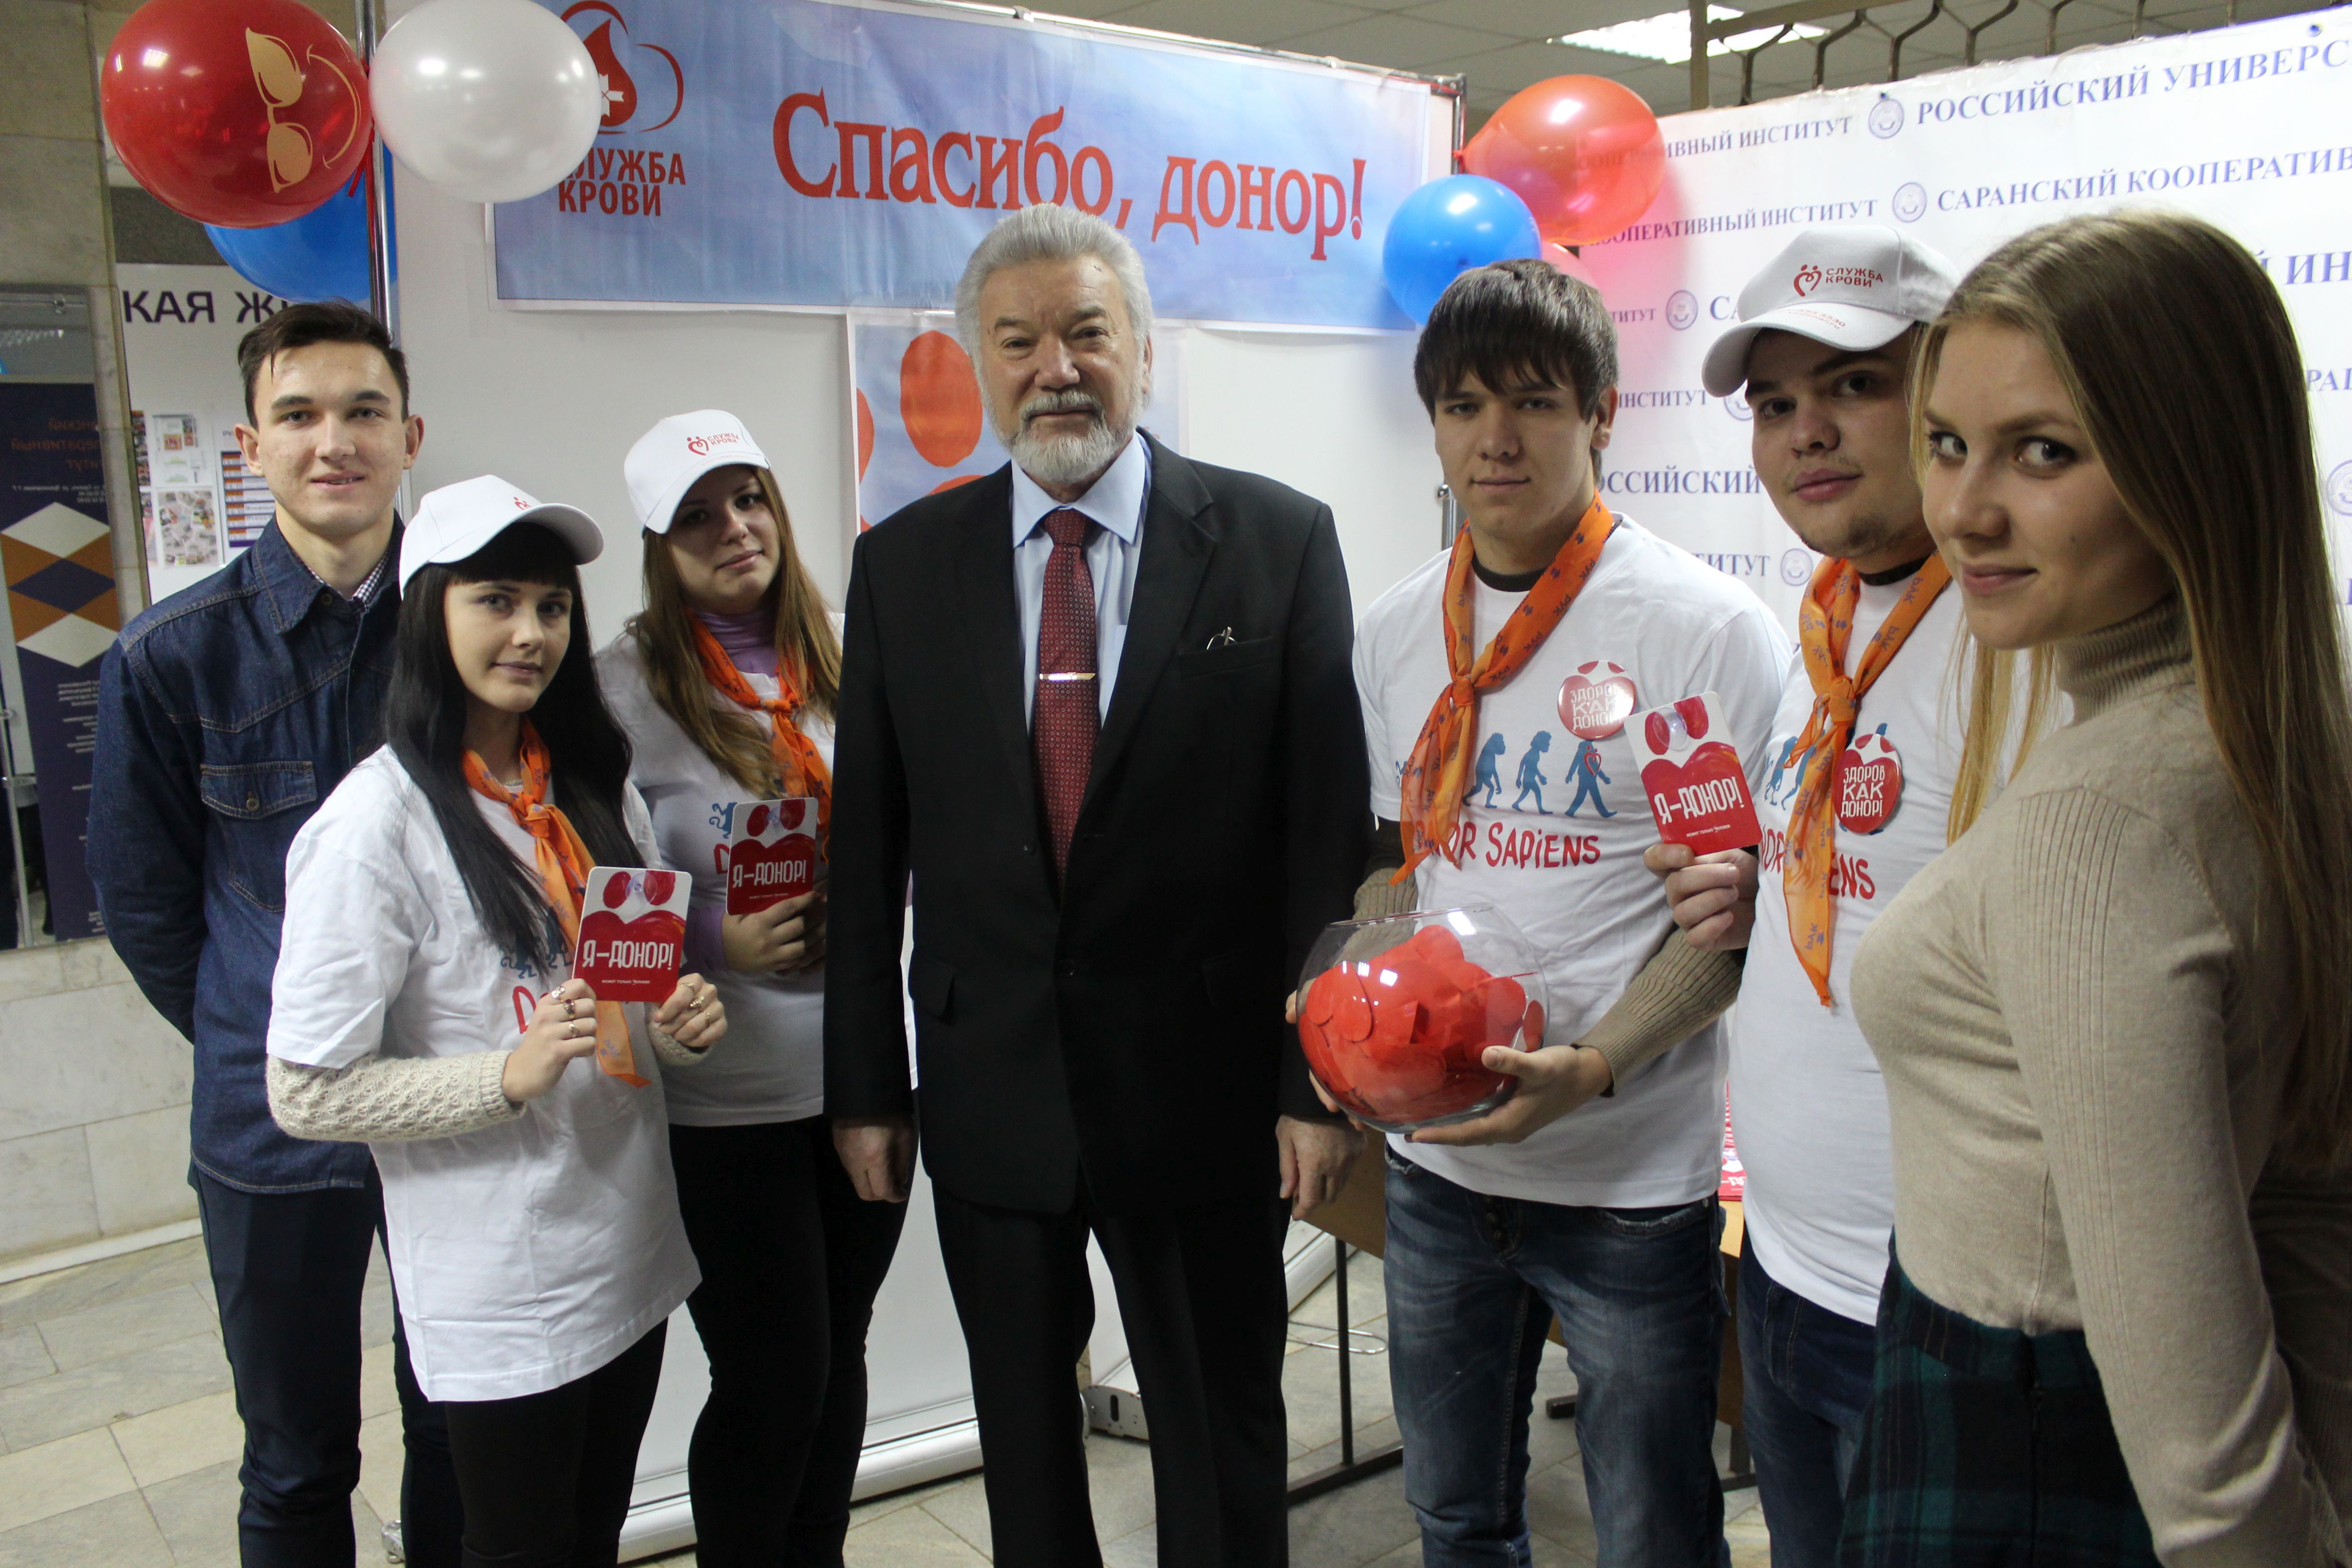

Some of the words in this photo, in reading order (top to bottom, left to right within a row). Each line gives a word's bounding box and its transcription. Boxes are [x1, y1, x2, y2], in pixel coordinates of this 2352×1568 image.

[1917, 64, 2151, 124] РОССИЙСКИЙ
[1739, 116, 1852, 148] ИНСТИТУТ
[567, 147, 686, 185] ЛУЖБА
[773, 87, 1133, 229] Спасибо,
[1151, 155, 1367, 261] донор!
[559, 180, 661, 216] КРОВИ
[1937, 168, 2118, 212] САРАНСКИЙ
[1590, 208, 1757, 245] ОПЕРАТИВНЫЙ
[1762, 199, 1878, 226] ИНСТИТУТ
[1826, 268, 1884, 283] СЛУЖБА
[1826, 275, 1872, 289] КРОВИ
[1842, 782, 1884, 801] КАК
[1843, 765, 1885, 784] ЗДОРОВ
[1840, 799, 1883, 818] ДОНОР!
